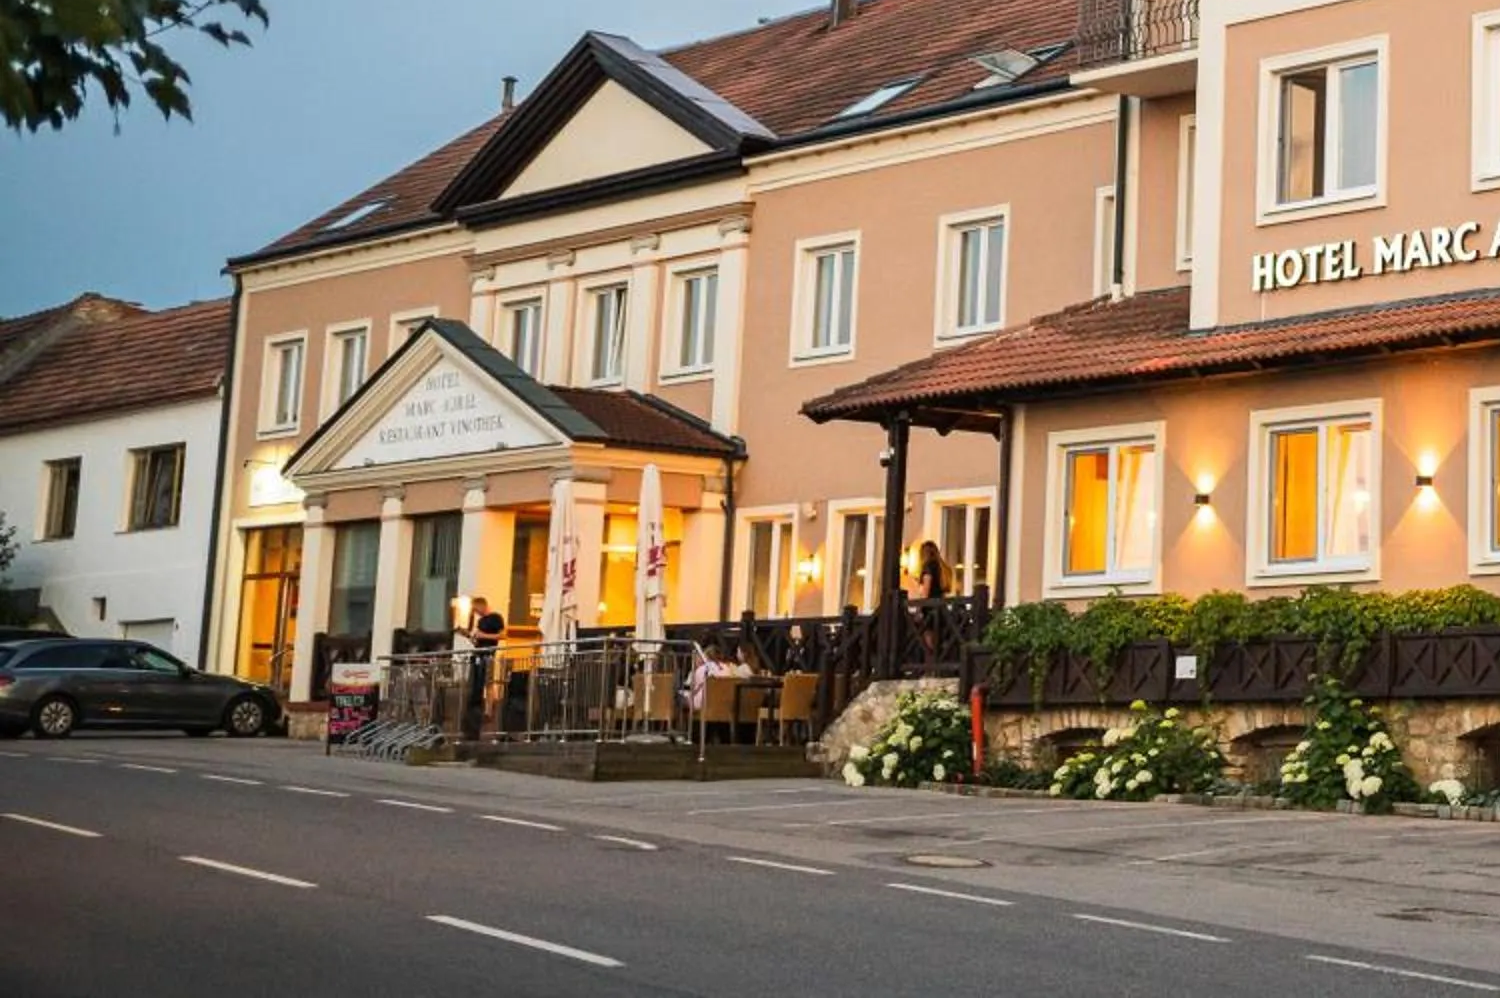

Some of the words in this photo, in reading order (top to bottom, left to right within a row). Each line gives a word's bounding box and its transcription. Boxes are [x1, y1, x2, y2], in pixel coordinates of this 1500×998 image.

[1252, 240, 1363, 292] HOTEL
[1372, 221, 1480, 275] MARC
[425, 372, 461, 391] HOTEL
